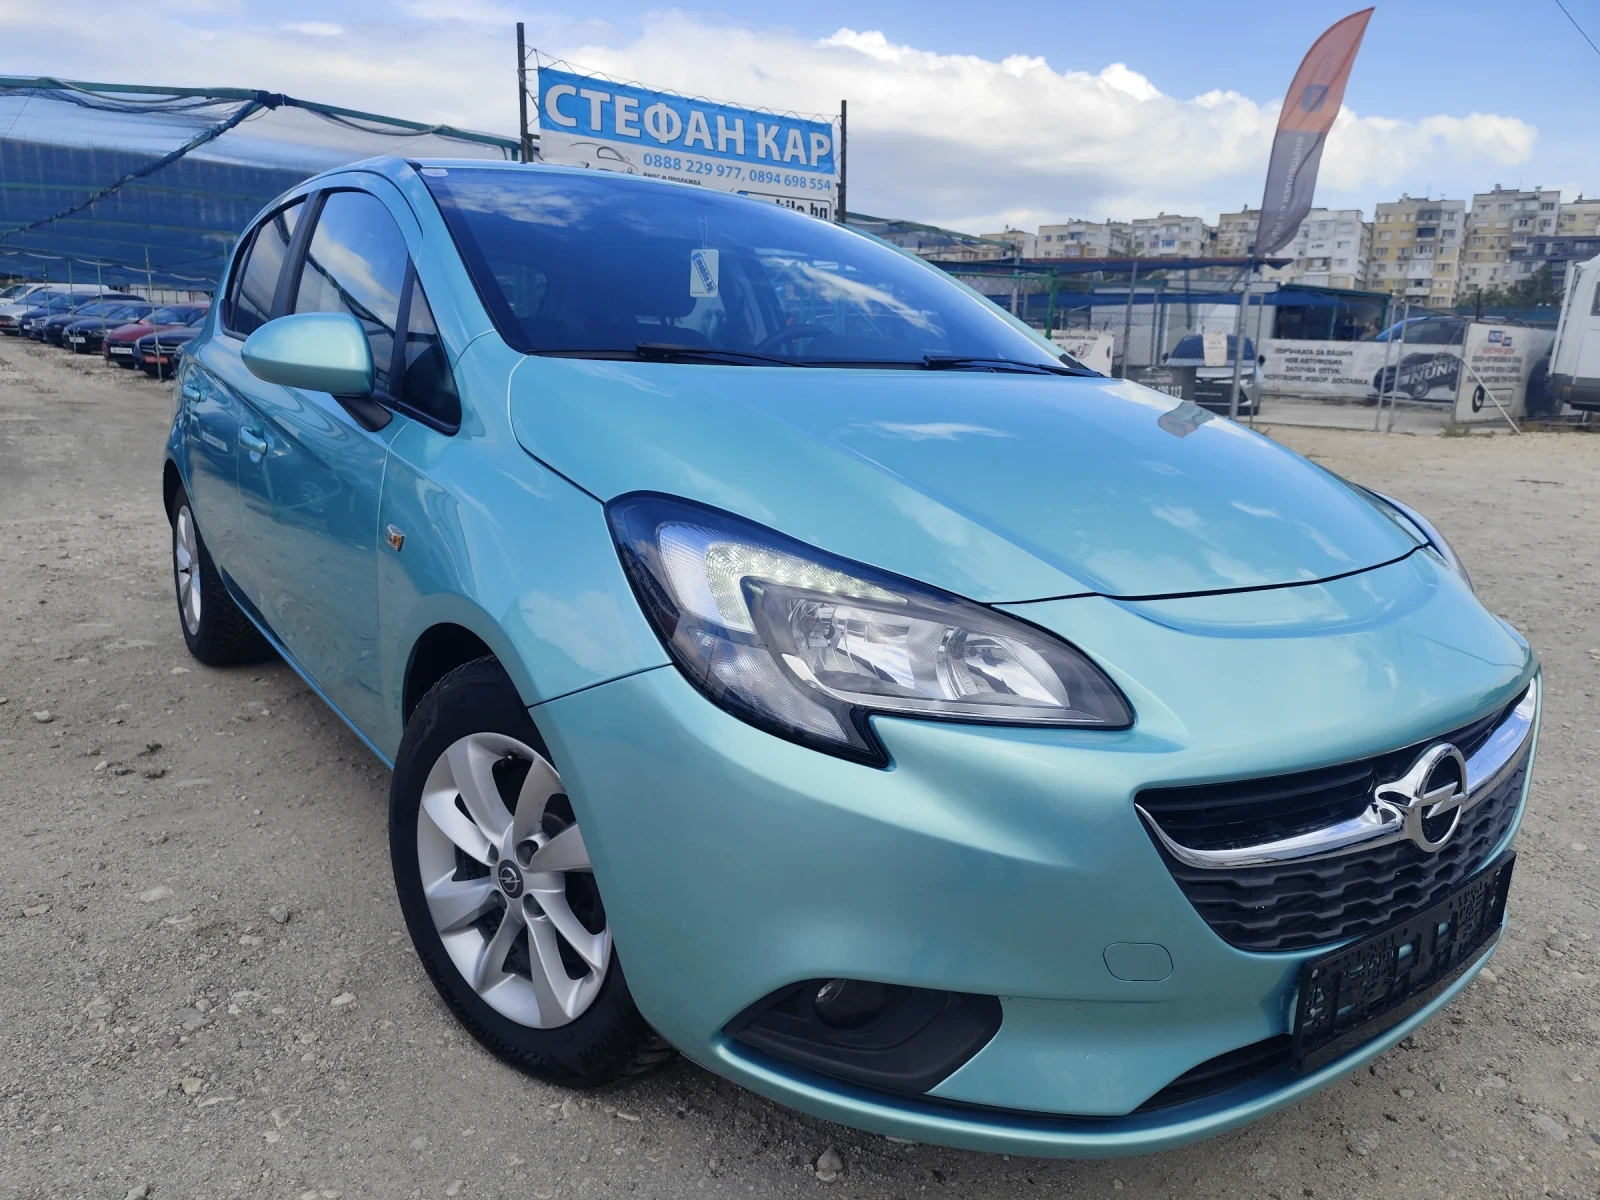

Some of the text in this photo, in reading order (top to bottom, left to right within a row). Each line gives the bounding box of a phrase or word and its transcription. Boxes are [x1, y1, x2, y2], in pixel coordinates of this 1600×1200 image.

[545, 84, 832, 168] СТЕФАН КАР
[643, 152, 831, 191] 0888 229 977, 0894 698 554
